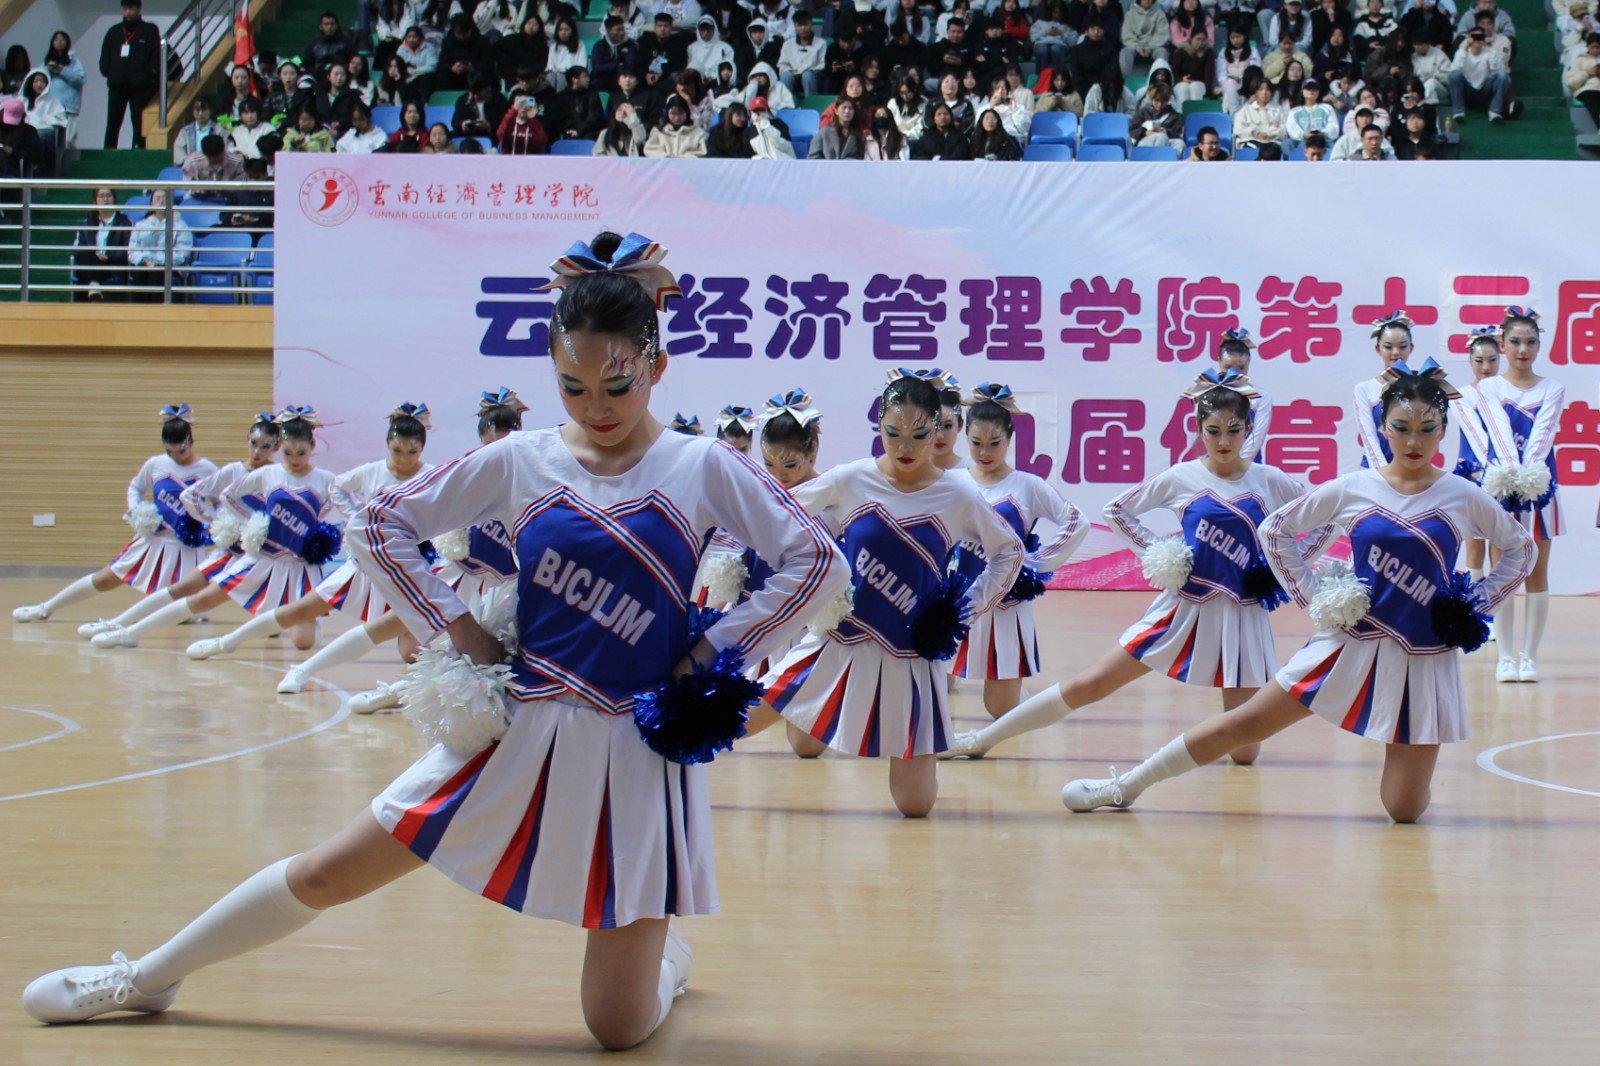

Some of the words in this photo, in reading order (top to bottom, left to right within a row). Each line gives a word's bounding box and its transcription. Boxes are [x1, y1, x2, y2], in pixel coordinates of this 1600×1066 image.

[368, 211, 408, 219] YUNNAN
[412, 211, 457, 219] COLLEGE
[461, 211, 475, 219] OF
[479, 212, 528, 220] BUSINESS
[532, 212, 600, 221] MANAGEMENT
[475, 273, 1600, 367] 云经济管理学院第十三届
[1195, 518, 1251, 570] BJCJLJM
[1367, 544, 1437, 607] BJCJLJM
[532, 547, 656, 647] BJCJLJM
[855, 547, 919, 615] BJCJLJM
